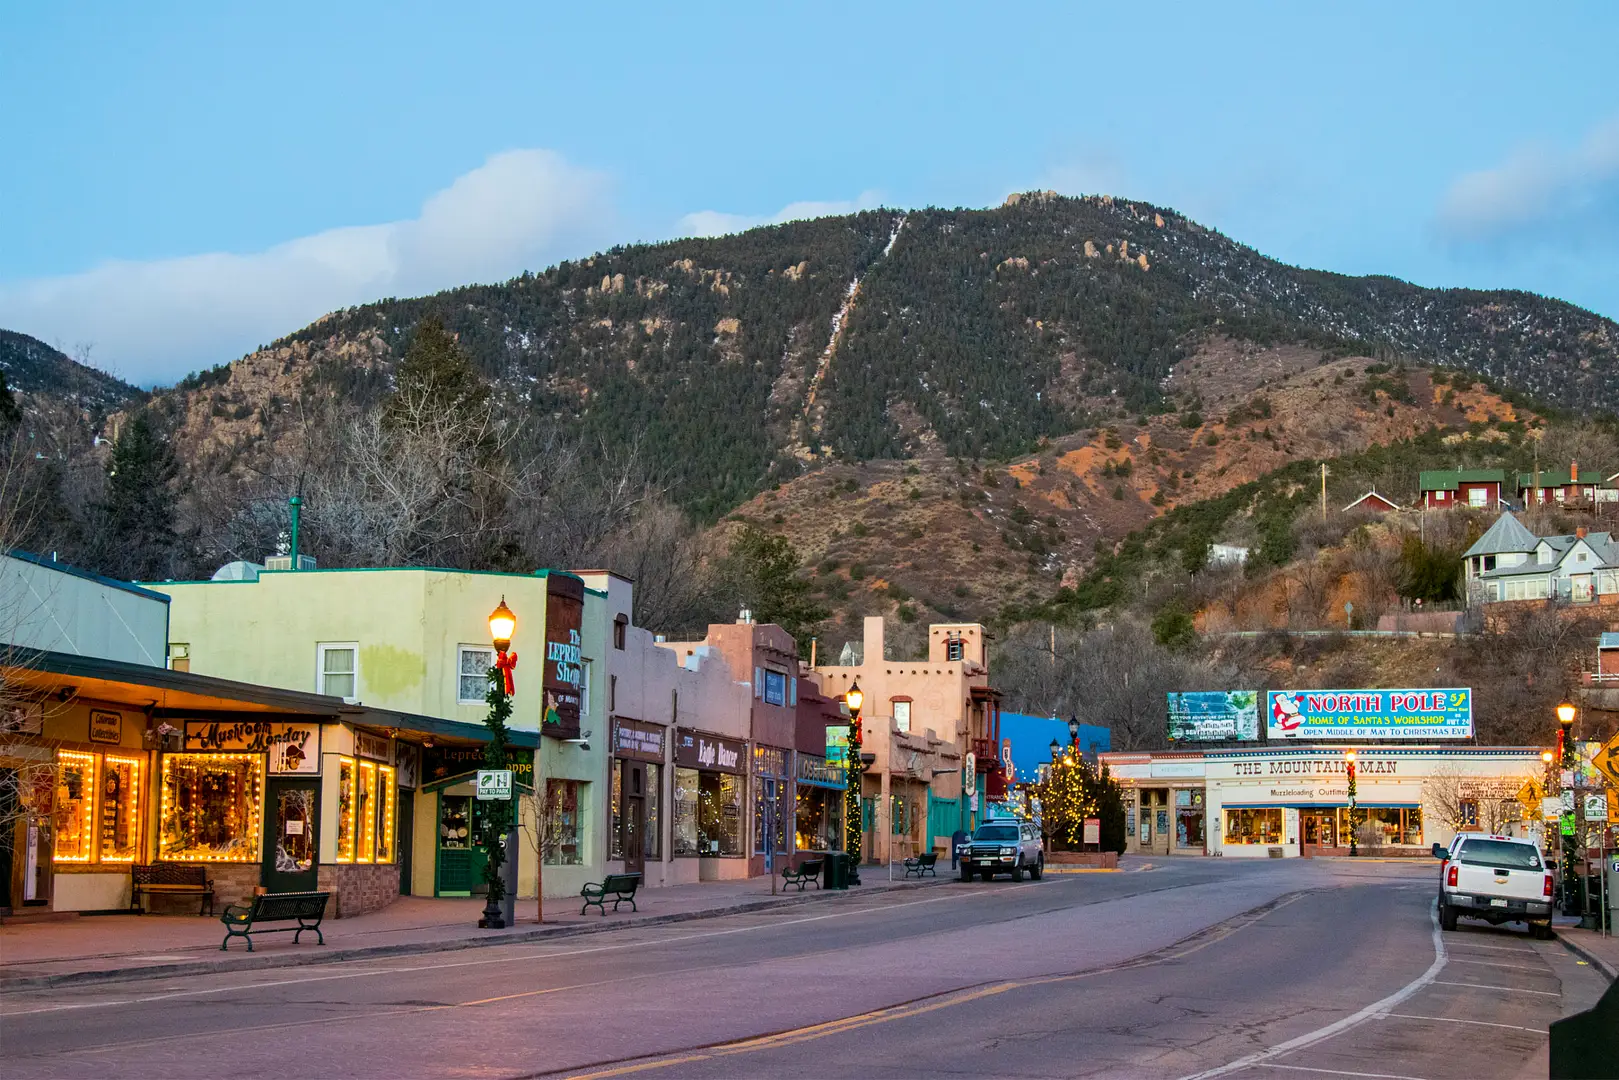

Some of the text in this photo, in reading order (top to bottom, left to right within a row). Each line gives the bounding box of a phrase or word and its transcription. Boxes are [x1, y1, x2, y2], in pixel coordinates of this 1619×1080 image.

[1307, 692, 1446, 712] NORTH POLE
[1450, 693, 1456, 702] 5
[1308, 715, 1444, 724] HOME OF SANTA'S WORKSHOP
[200, 722, 271, 748] Mushroom
[247, 726, 310, 750] Monday
[1234, 763, 1262, 775] THE
[1359, 761, 1397, 773] MAN
[1270, 789, 1313, 798] Muzzleloading
